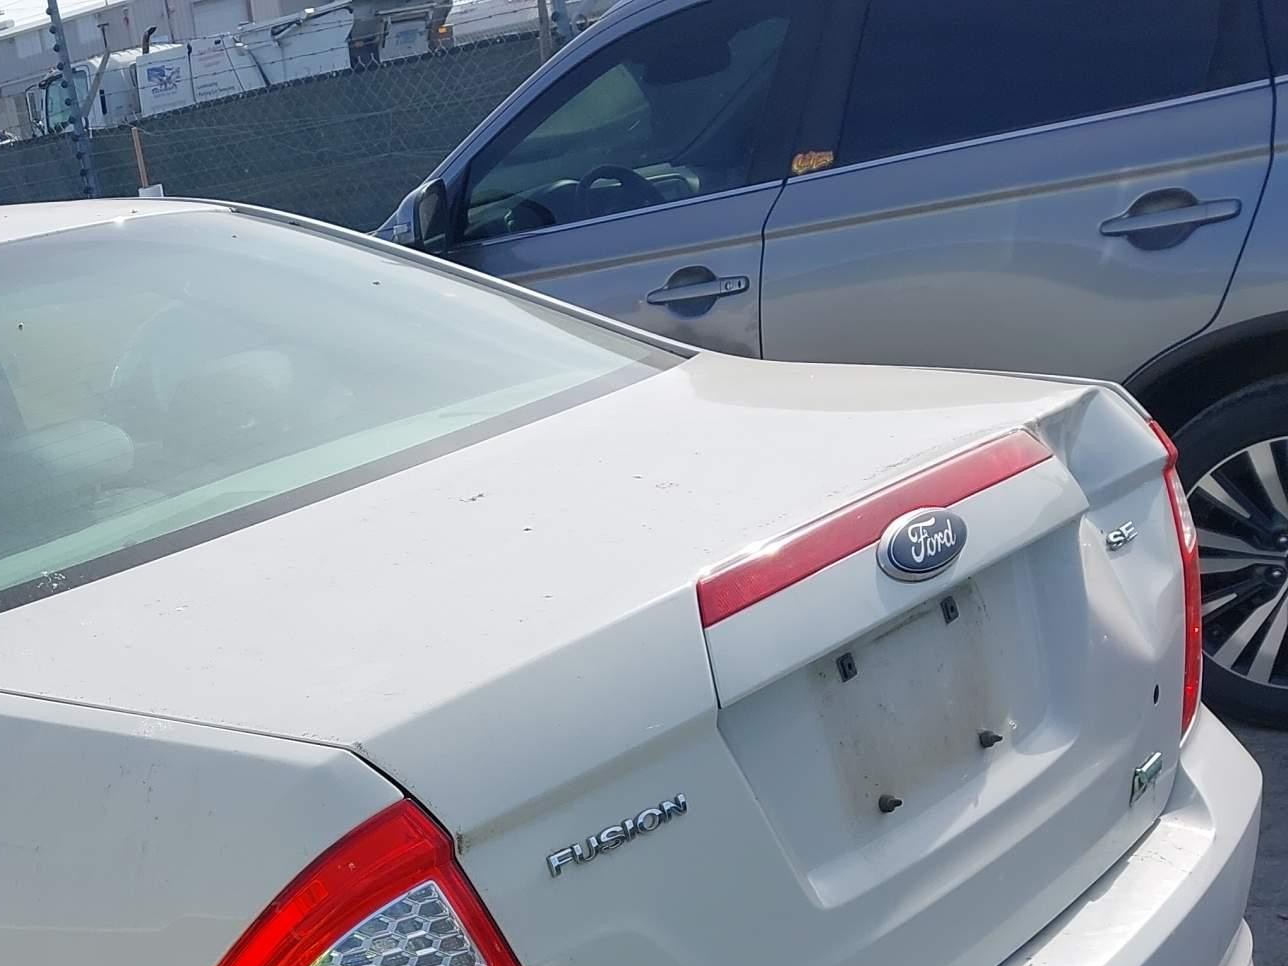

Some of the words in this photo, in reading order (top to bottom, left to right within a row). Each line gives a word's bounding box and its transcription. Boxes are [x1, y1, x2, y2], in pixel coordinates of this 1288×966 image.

[908, 516, 957, 563] Ford
[1107, 521, 1138, 550] SE
[546, 793, 689, 878] FUSION
